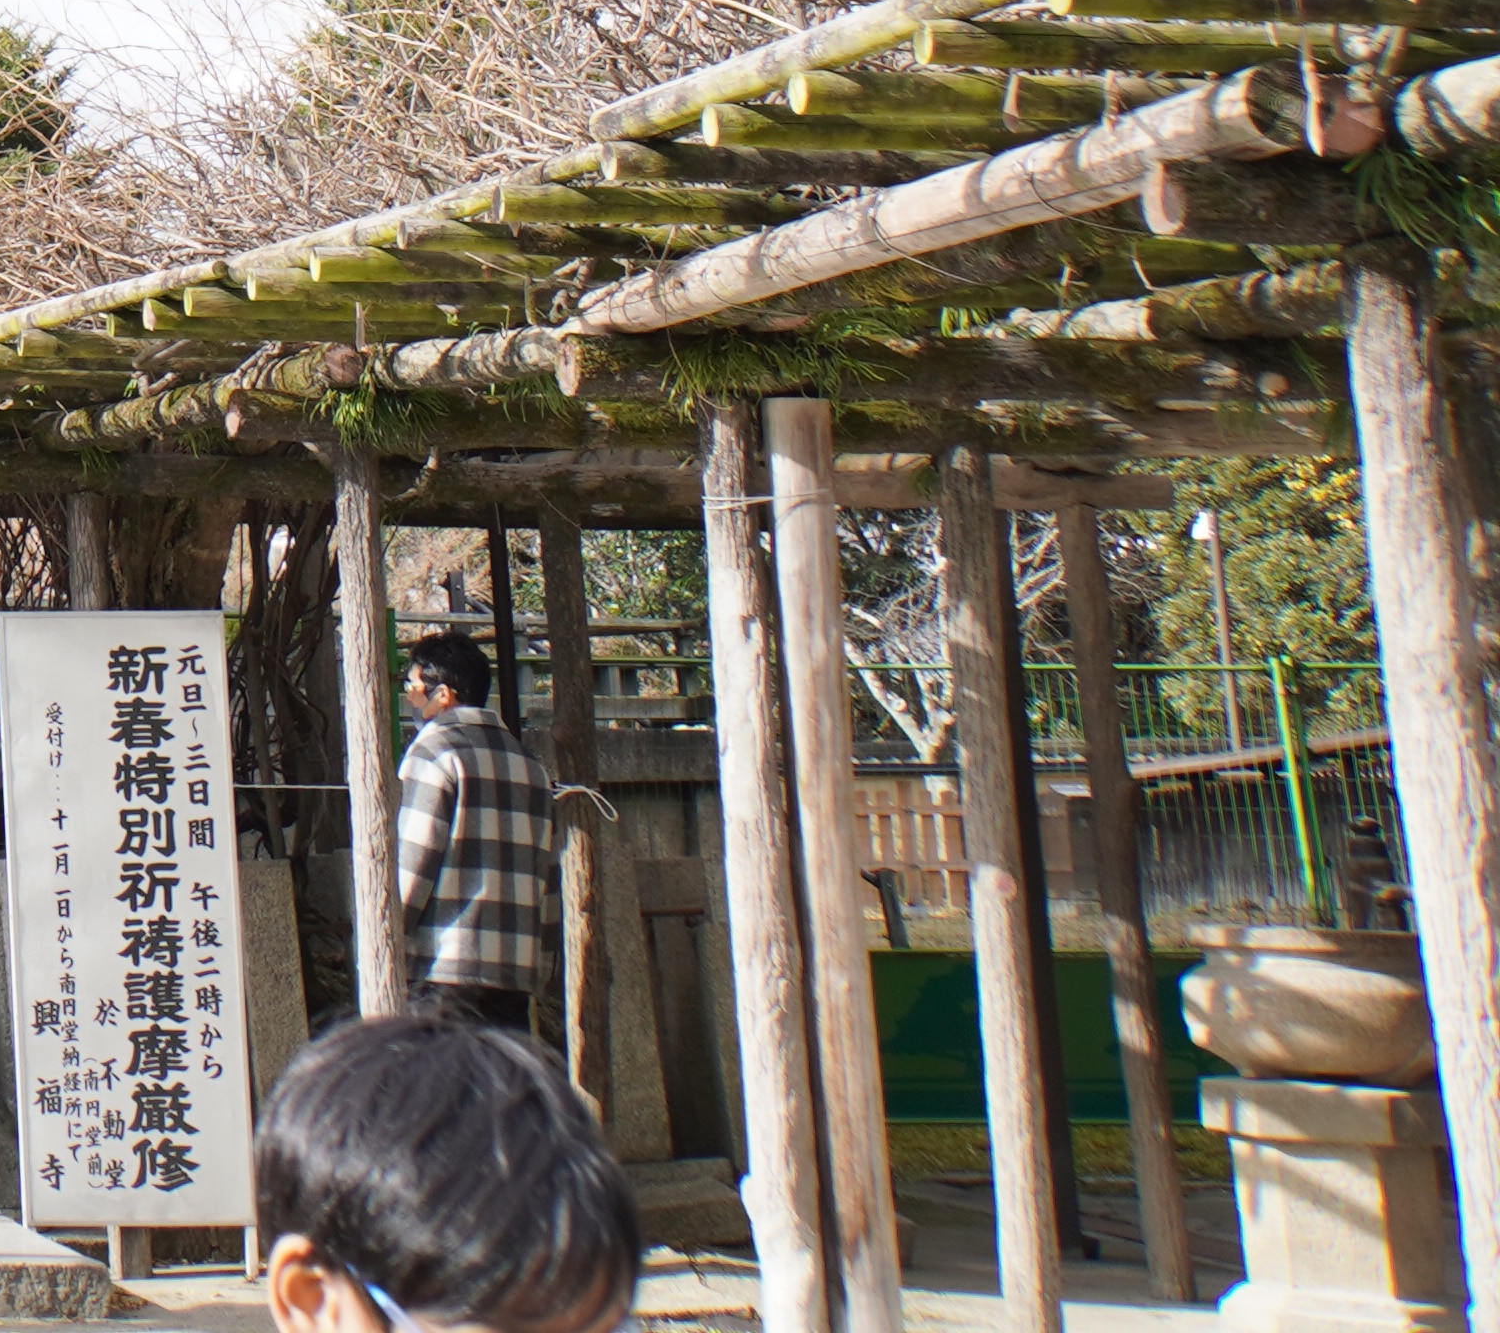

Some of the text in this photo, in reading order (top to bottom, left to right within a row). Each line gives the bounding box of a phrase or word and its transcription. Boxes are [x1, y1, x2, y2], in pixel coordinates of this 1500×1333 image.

[190, 882, 224, 1080] 午後二時から
[31, 1000, 66, 1192] 興福寺
